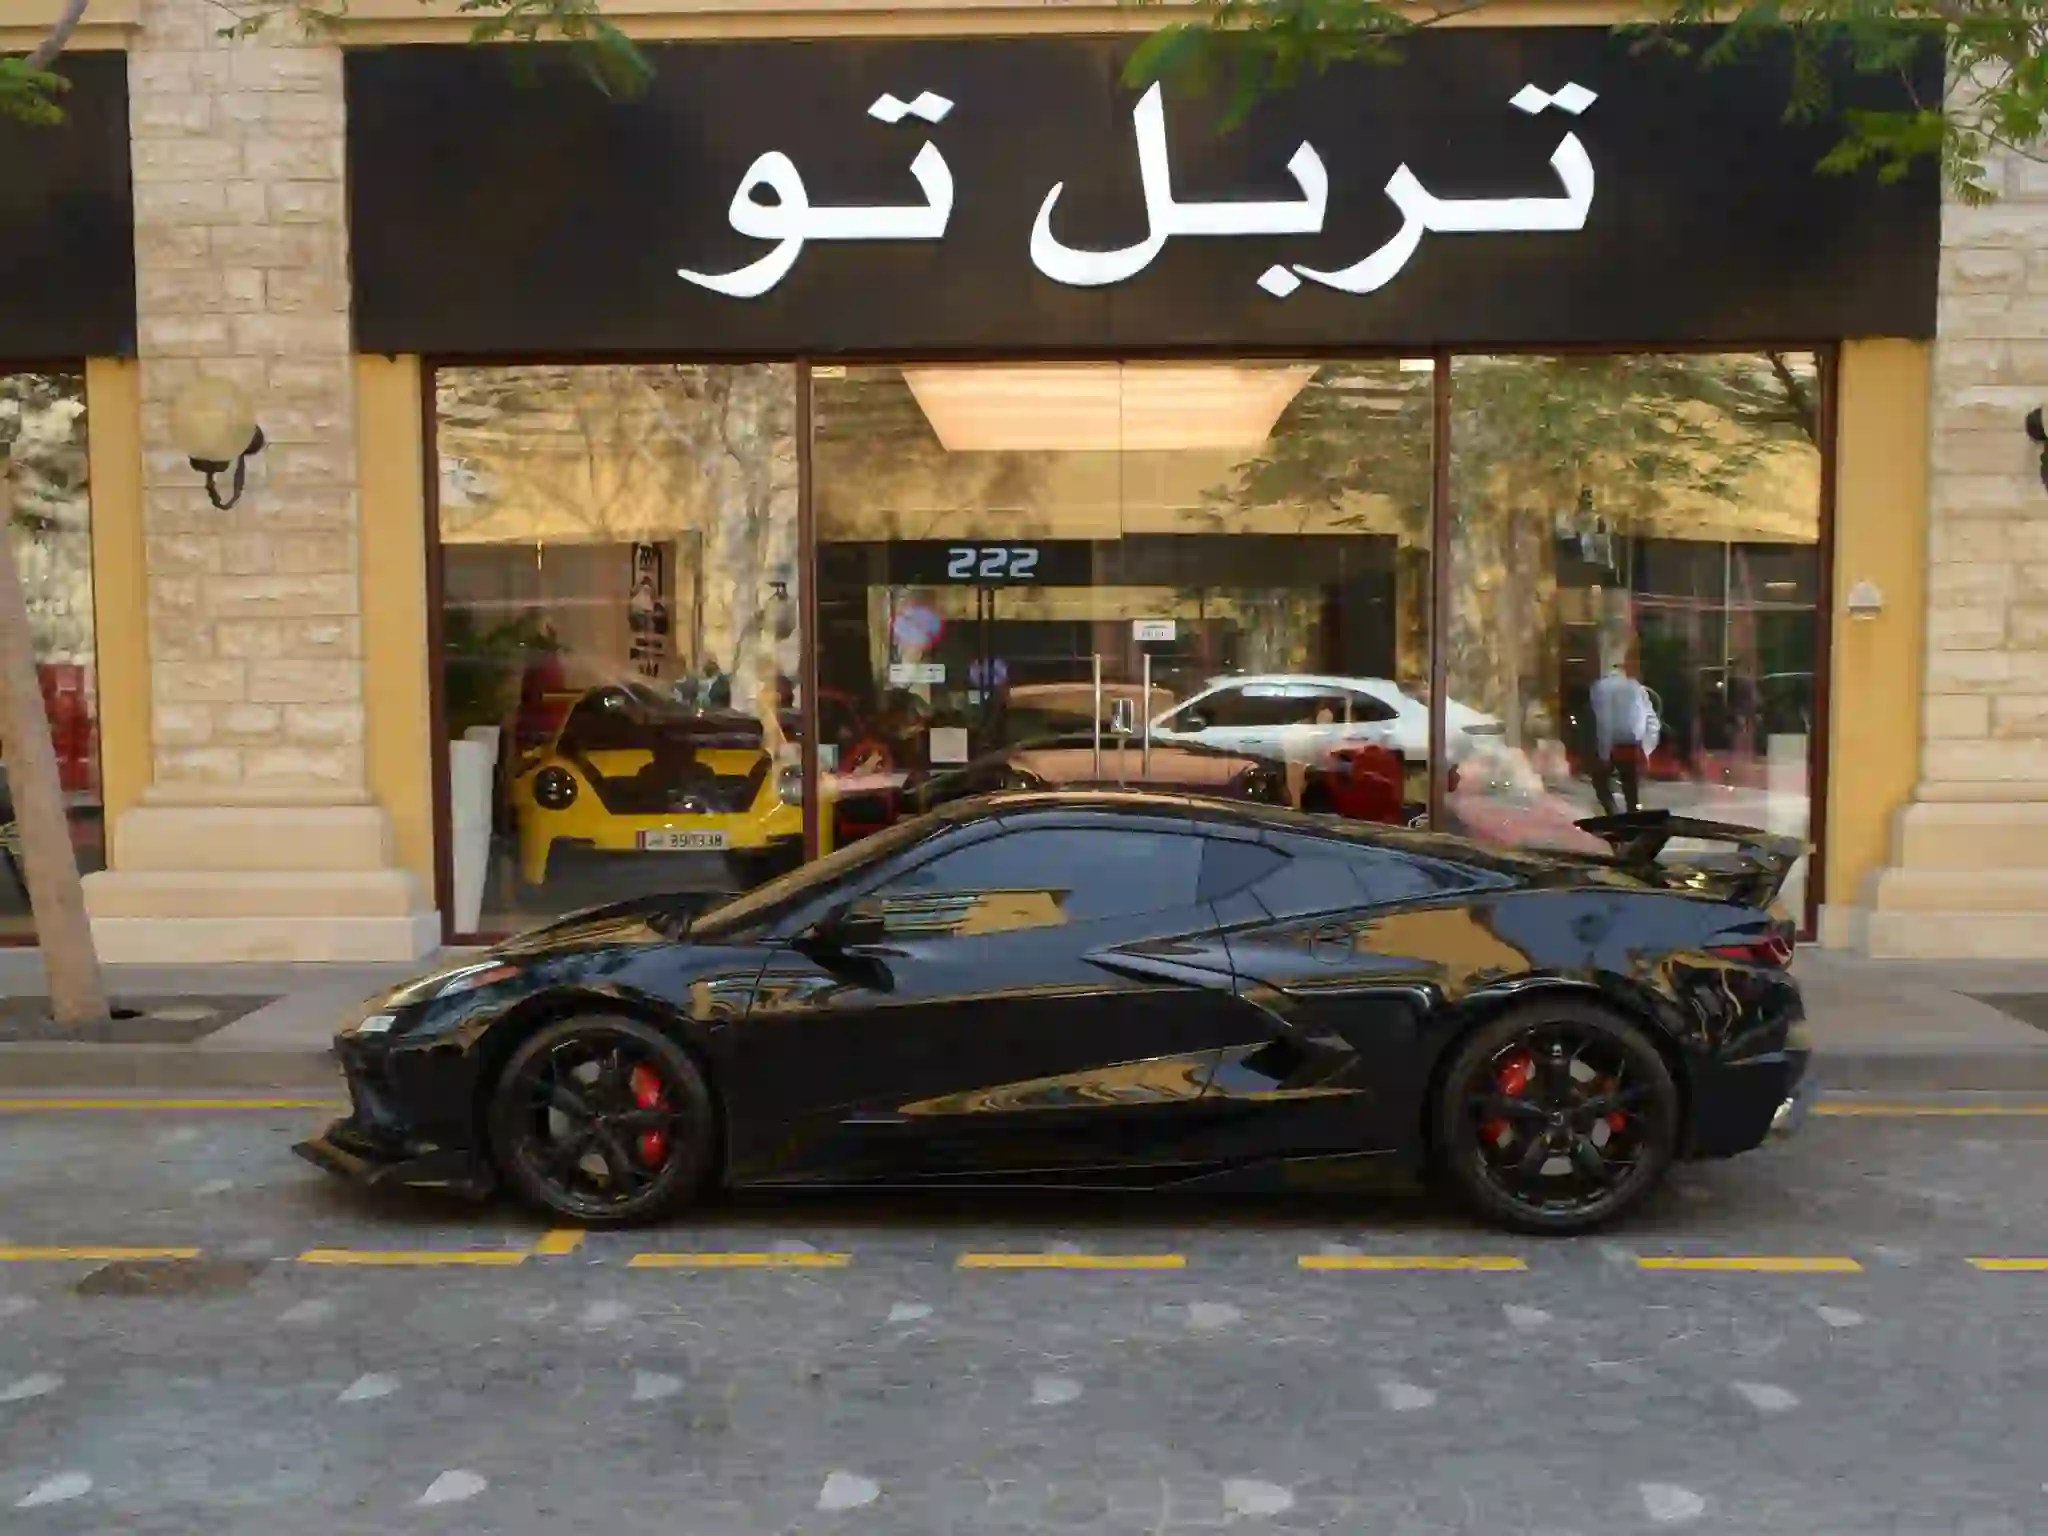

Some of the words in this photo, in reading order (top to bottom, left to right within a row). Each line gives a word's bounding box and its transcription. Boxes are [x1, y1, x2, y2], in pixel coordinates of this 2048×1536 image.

[677, 90, 955, 299] تو
[1030, 80, 1599, 298] تربل
[947, 547, 1040, 578] 222
